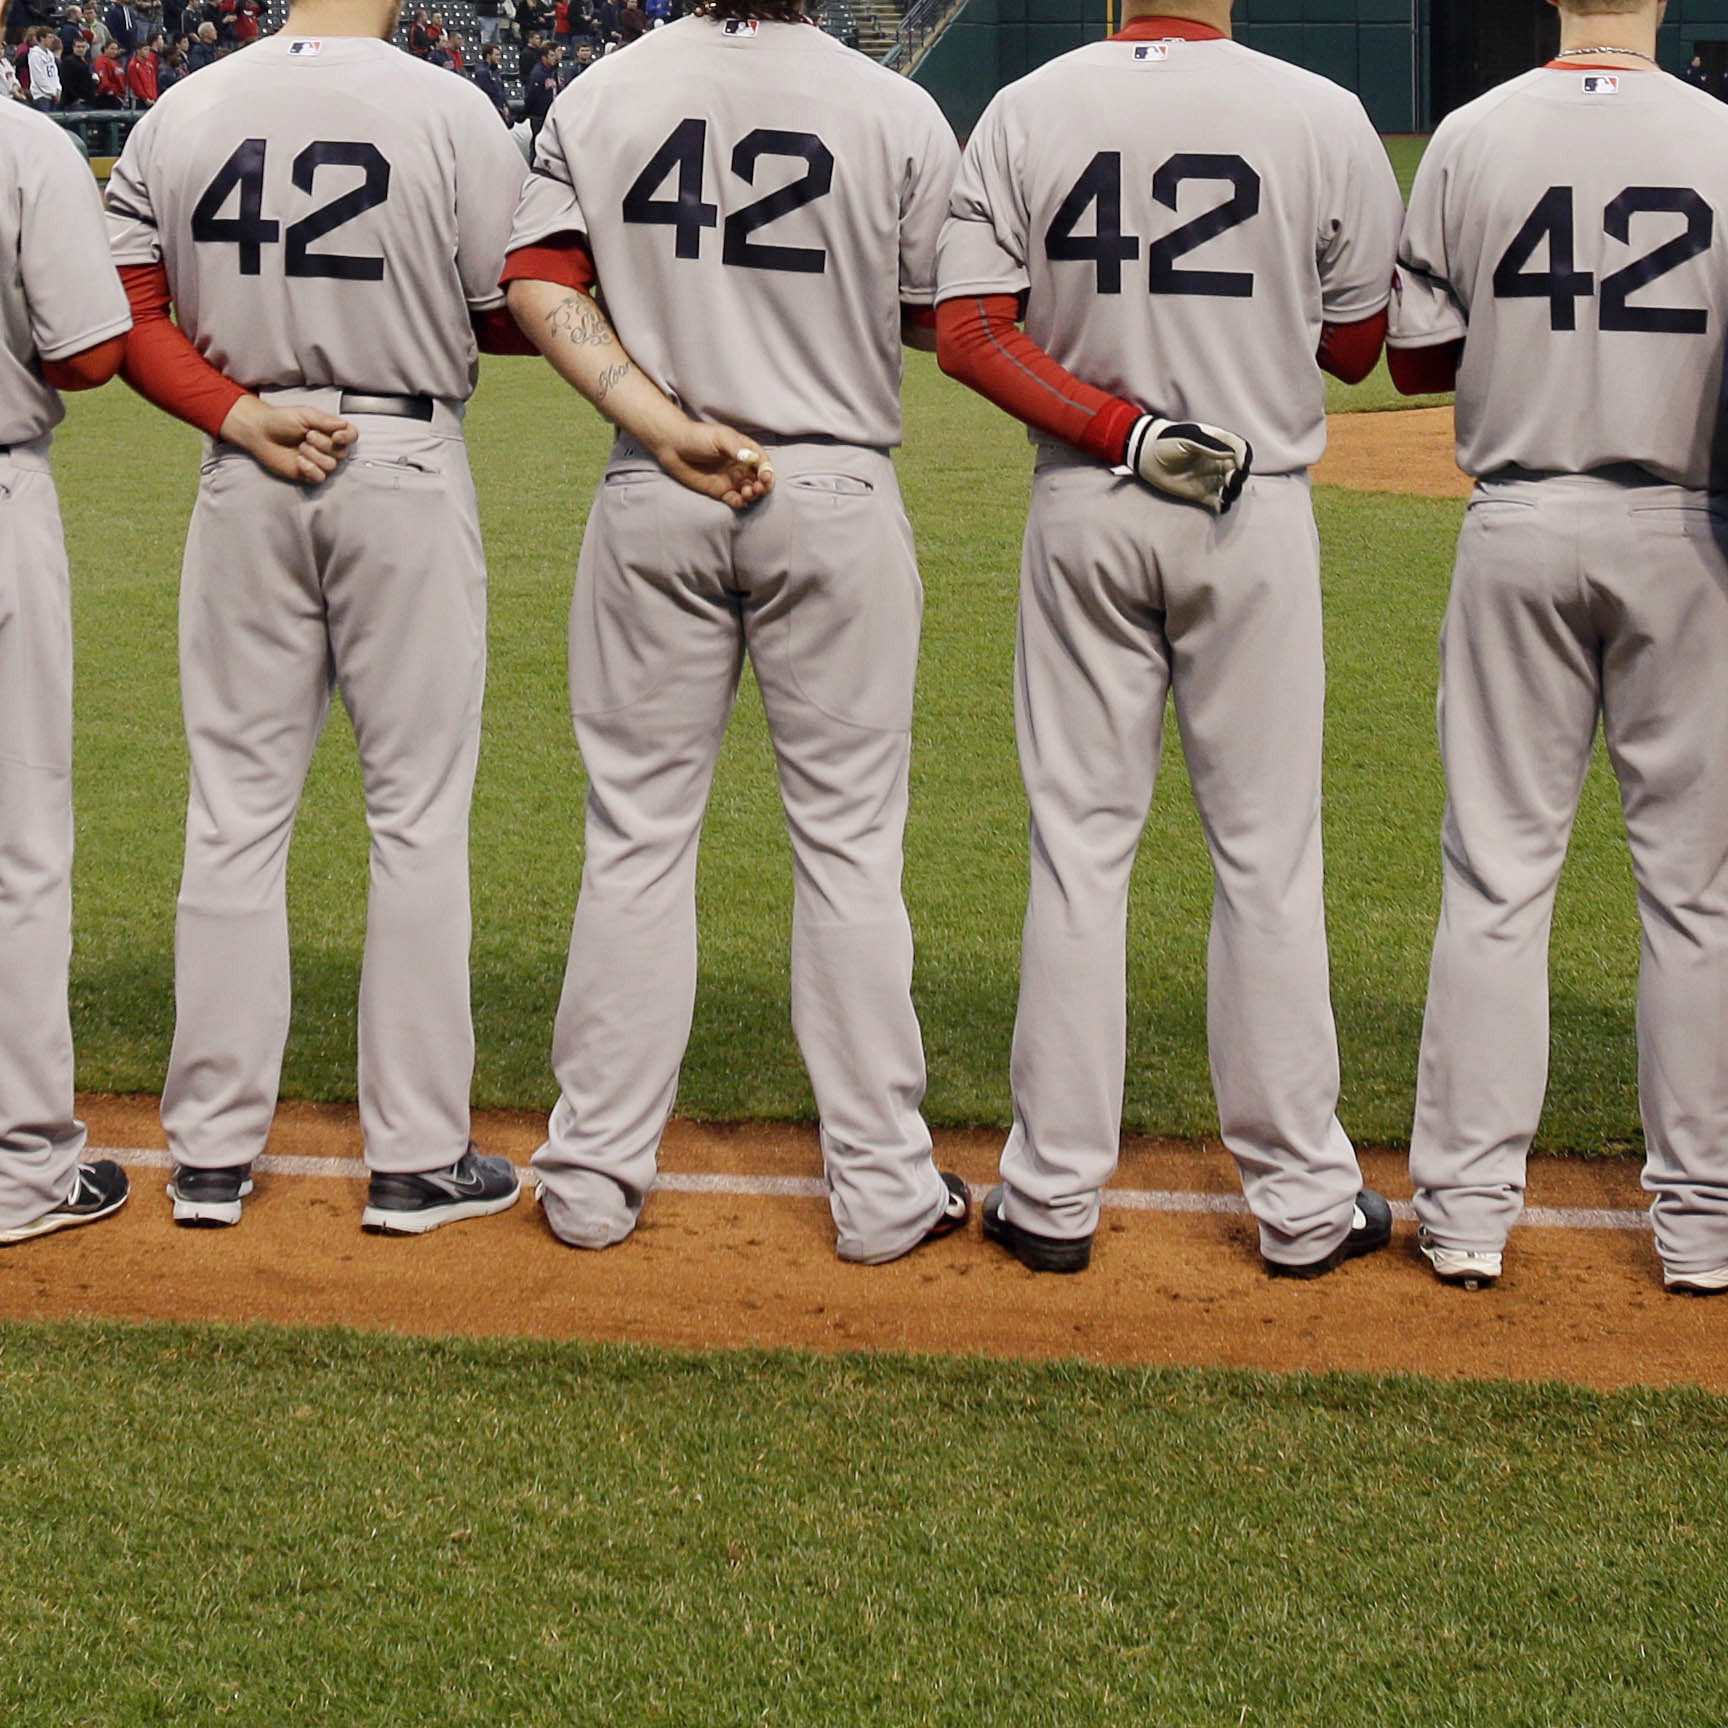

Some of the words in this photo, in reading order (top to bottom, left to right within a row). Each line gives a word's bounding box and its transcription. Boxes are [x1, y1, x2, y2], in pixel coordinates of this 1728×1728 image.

[191, 137, 391, 281] 42
[623, 117, 833, 275] 42
[1044, 150, 1261, 298] 42
[1493, 185, 1715, 336] 42
